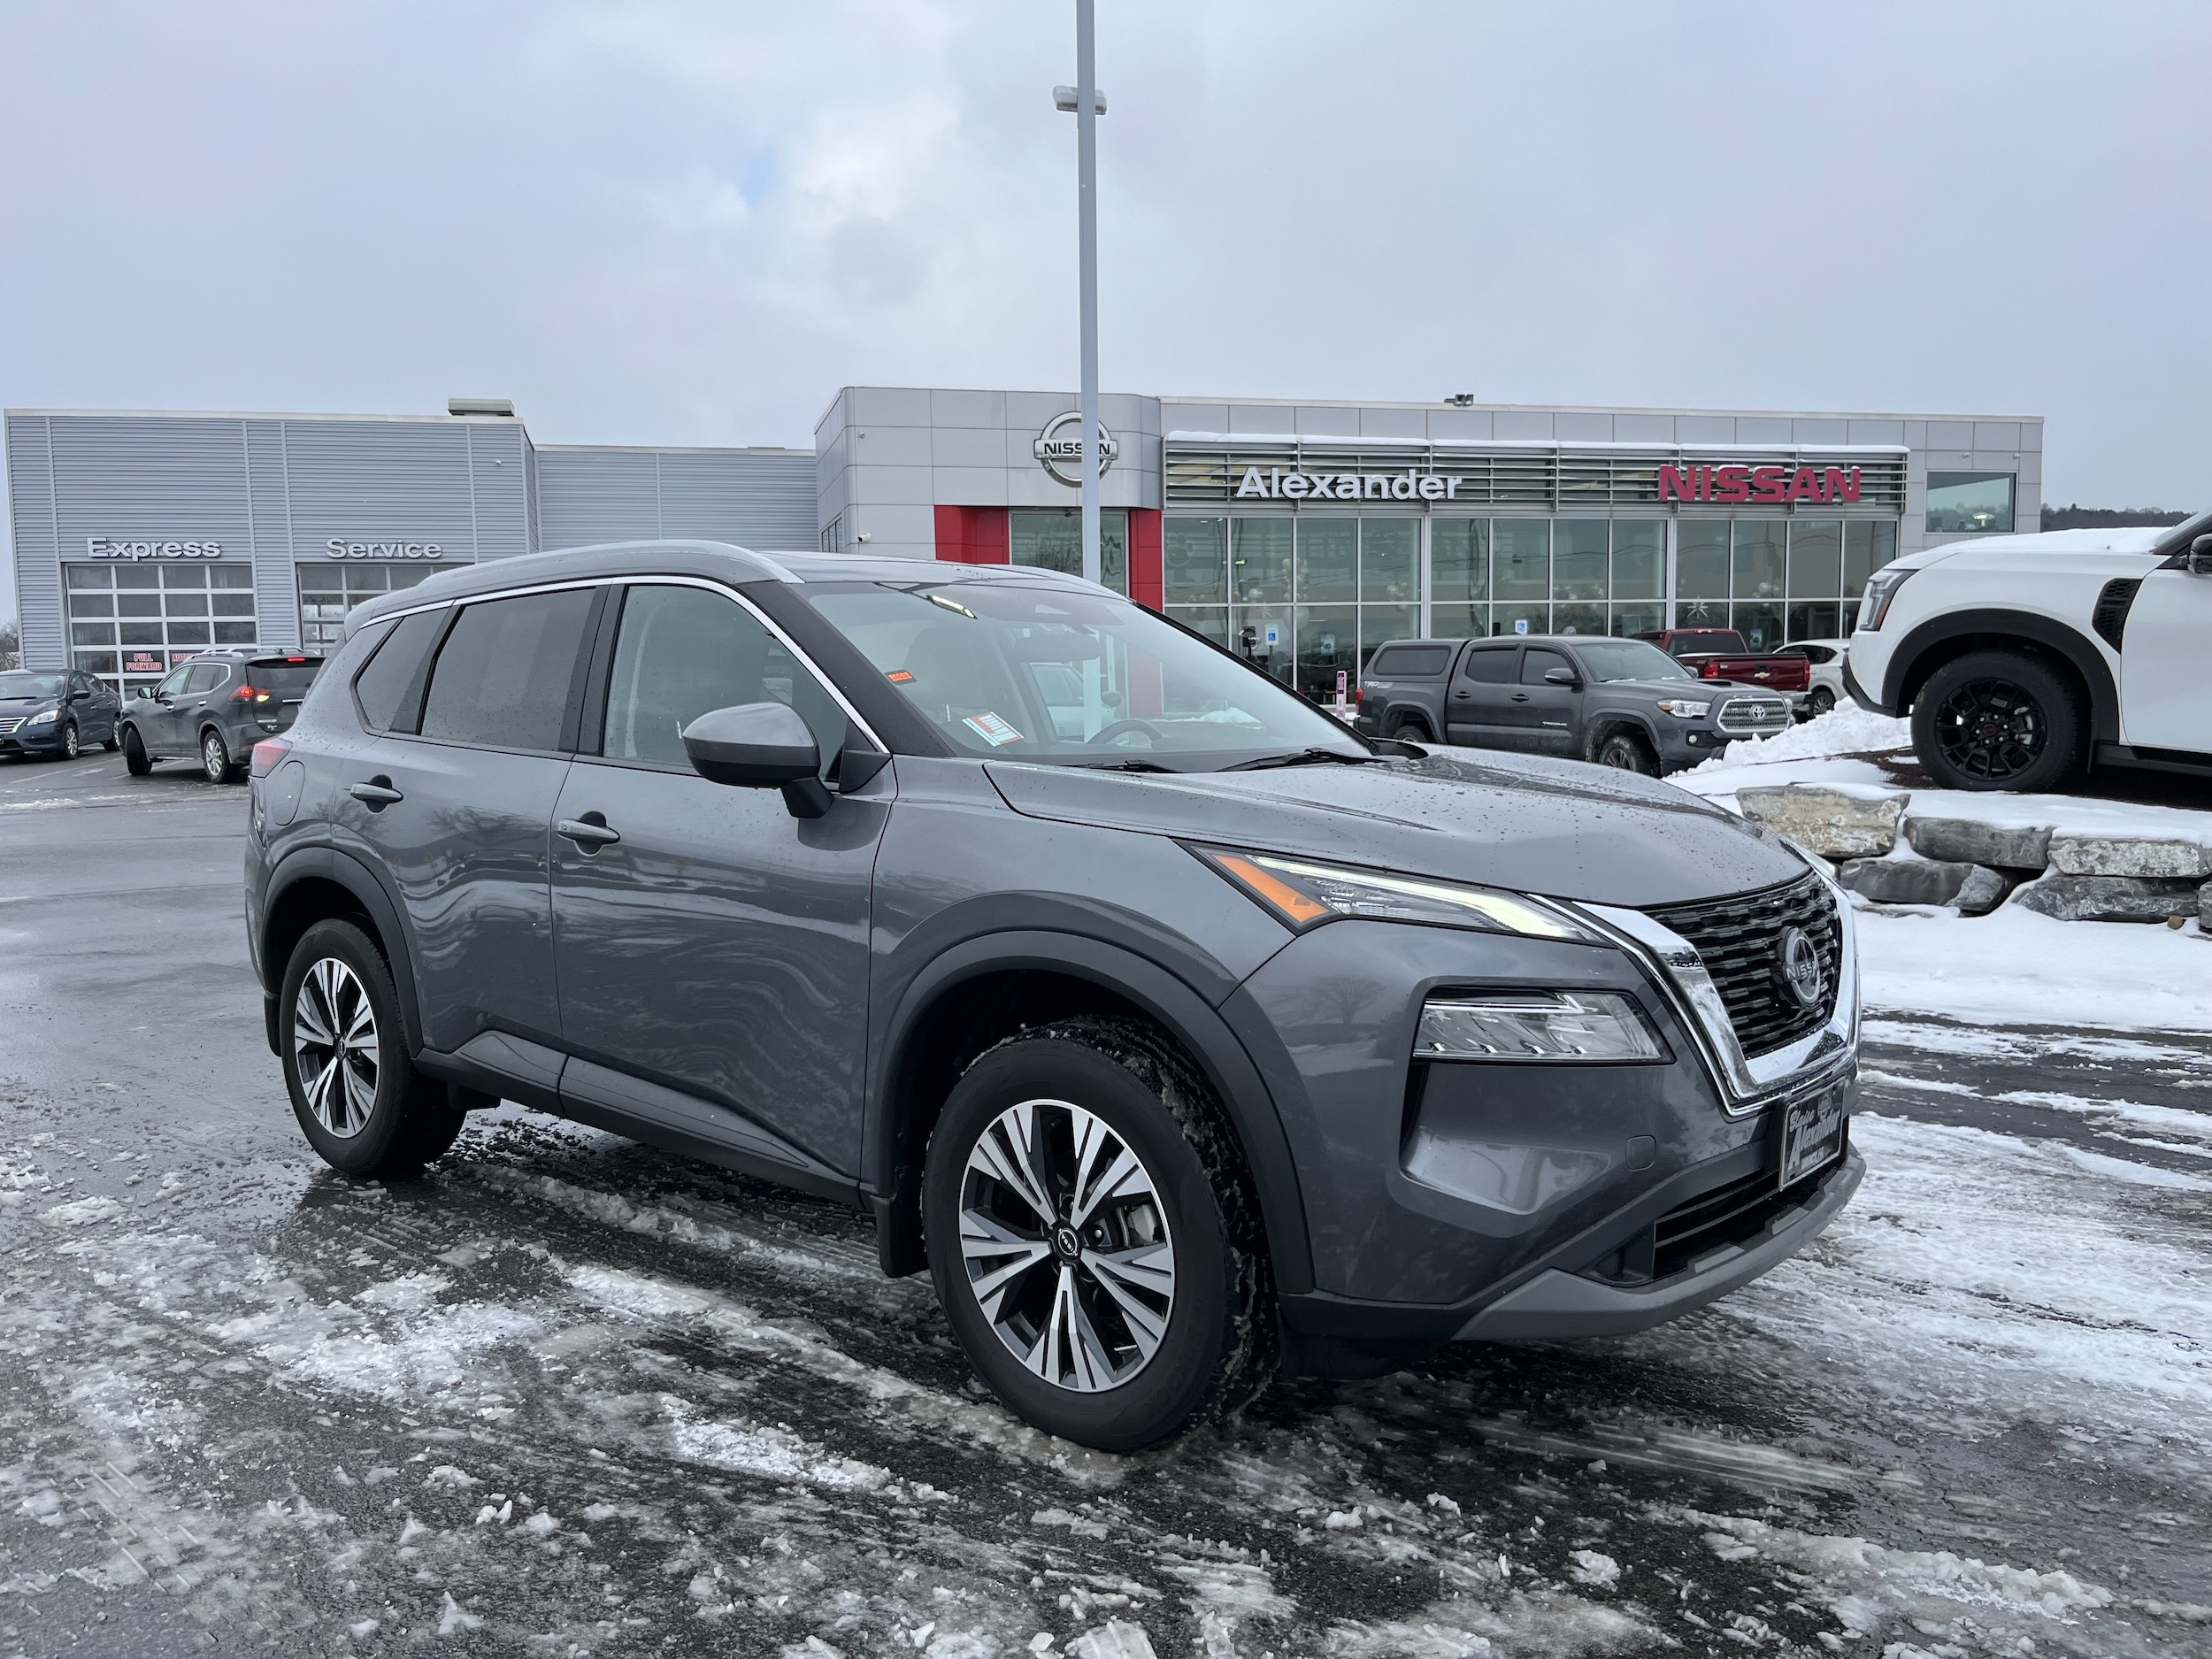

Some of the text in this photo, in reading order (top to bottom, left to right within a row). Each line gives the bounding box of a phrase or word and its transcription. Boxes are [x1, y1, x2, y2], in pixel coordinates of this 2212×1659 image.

[1044, 442, 1110, 456] NISSN
[1235, 466, 1462, 500] Alexander
[1658, 465, 1861, 503] NISSAN
[87, 537, 221, 562] Express
[326, 537, 442, 558] Service
[126, 662, 163, 672] FORWARD
[134, 653, 153, 662] PULL
[1787, 1109, 1840, 1171] Alexander
